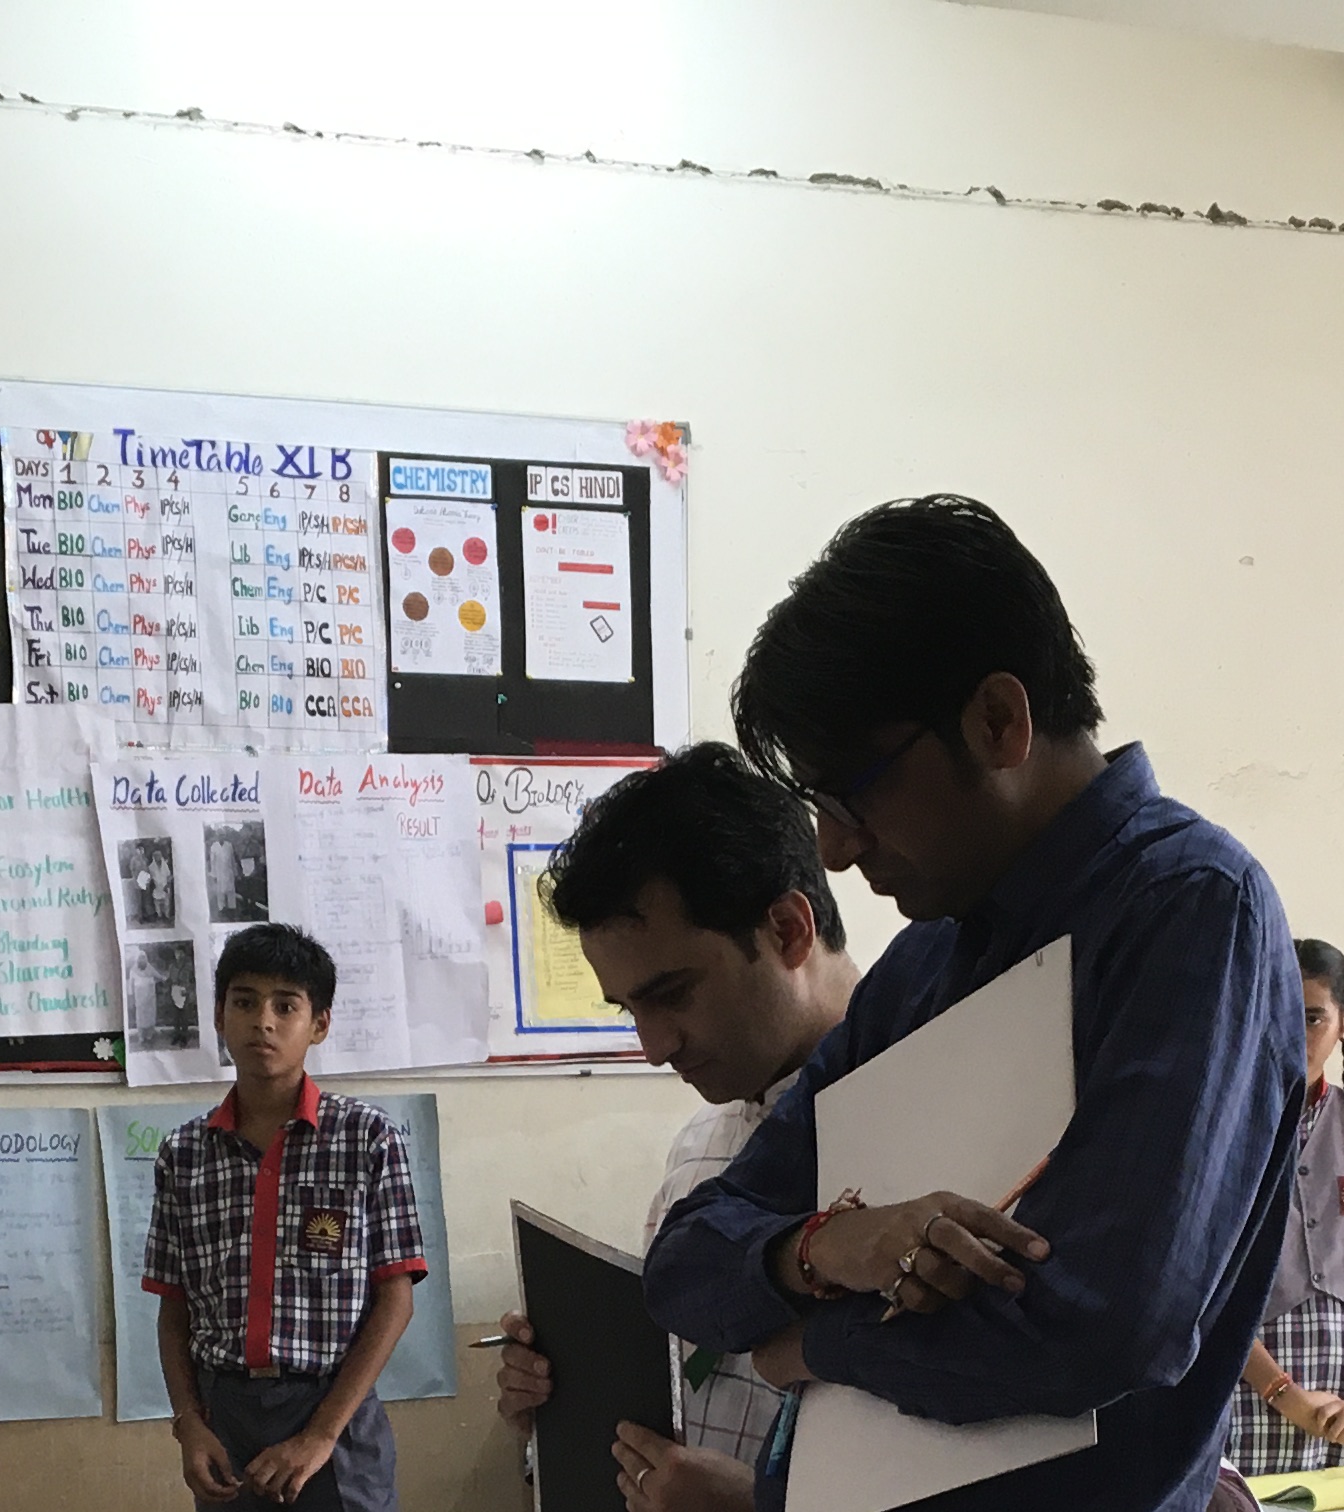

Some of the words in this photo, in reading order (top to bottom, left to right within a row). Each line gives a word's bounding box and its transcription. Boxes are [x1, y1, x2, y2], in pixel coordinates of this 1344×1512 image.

[14, 458, 50, 477] DAYS
[59, 462, 77, 484] 1
[96, 464, 112, 486] 2
[131, 469, 145, 489] 3
[166, 468, 180, 491] 4
[236, 476, 249, 496] 5
[269, 482, 280, 498] 6
[304, 484, 317, 500] 7
[339, 483, 350, 503] 8
[331, 447, 352, 481] B
[392, 465, 489, 495] CHEMISTRY
[529, 472, 542, 494] IP
[551, 475, 570, 497] CS
[579, 476, 621, 499] HINDI
[16, 482, 54, 510] Mon
[88, 494, 120, 514] Chem
[124, 494, 151, 519] Phys
[263, 507, 287, 531] Eng
[19, 528, 52, 554] Tue
[91, 536, 123, 557] Chem
[127, 538, 156, 560] Phys
[265, 544, 291, 571] Eng
[21, 564, 55, 590] Wed
[93, 573, 124, 593] Chem
[129, 572, 157, 593] Phys
[231, 576, 263, 598] Chem
[267, 576, 293, 605] Eng
[303, 582, 327, 603] P/C
[24, 604, 54, 632] Thu
[97, 609, 129, 634] Chem
[133, 613, 161, 636] Phys
[238, 615, 260, 636] Lib
[269, 617, 294, 644] Eng
[304, 620, 332, 645] P/C
[26, 637, 51, 667] Fri
[98, 646, 130, 667] Chem
[134, 647, 161, 671] Phys
[270, 655, 294, 680] Eng
[305, 657, 332, 678] BIO
[340, 658, 366, 679] BIO
[100, 685, 130, 705] Chem
[137, 687, 162, 716] Phys
[306, 694, 337, 718] CCA
[341, 695, 373, 718] CCA
[112, 769, 167, 806] Data
[176, 771, 261, 807] Collected
[298, 766, 343, 797] Data
[358, 764, 445, 806] Analysis
[396, 812, 441, 838] RESULT
